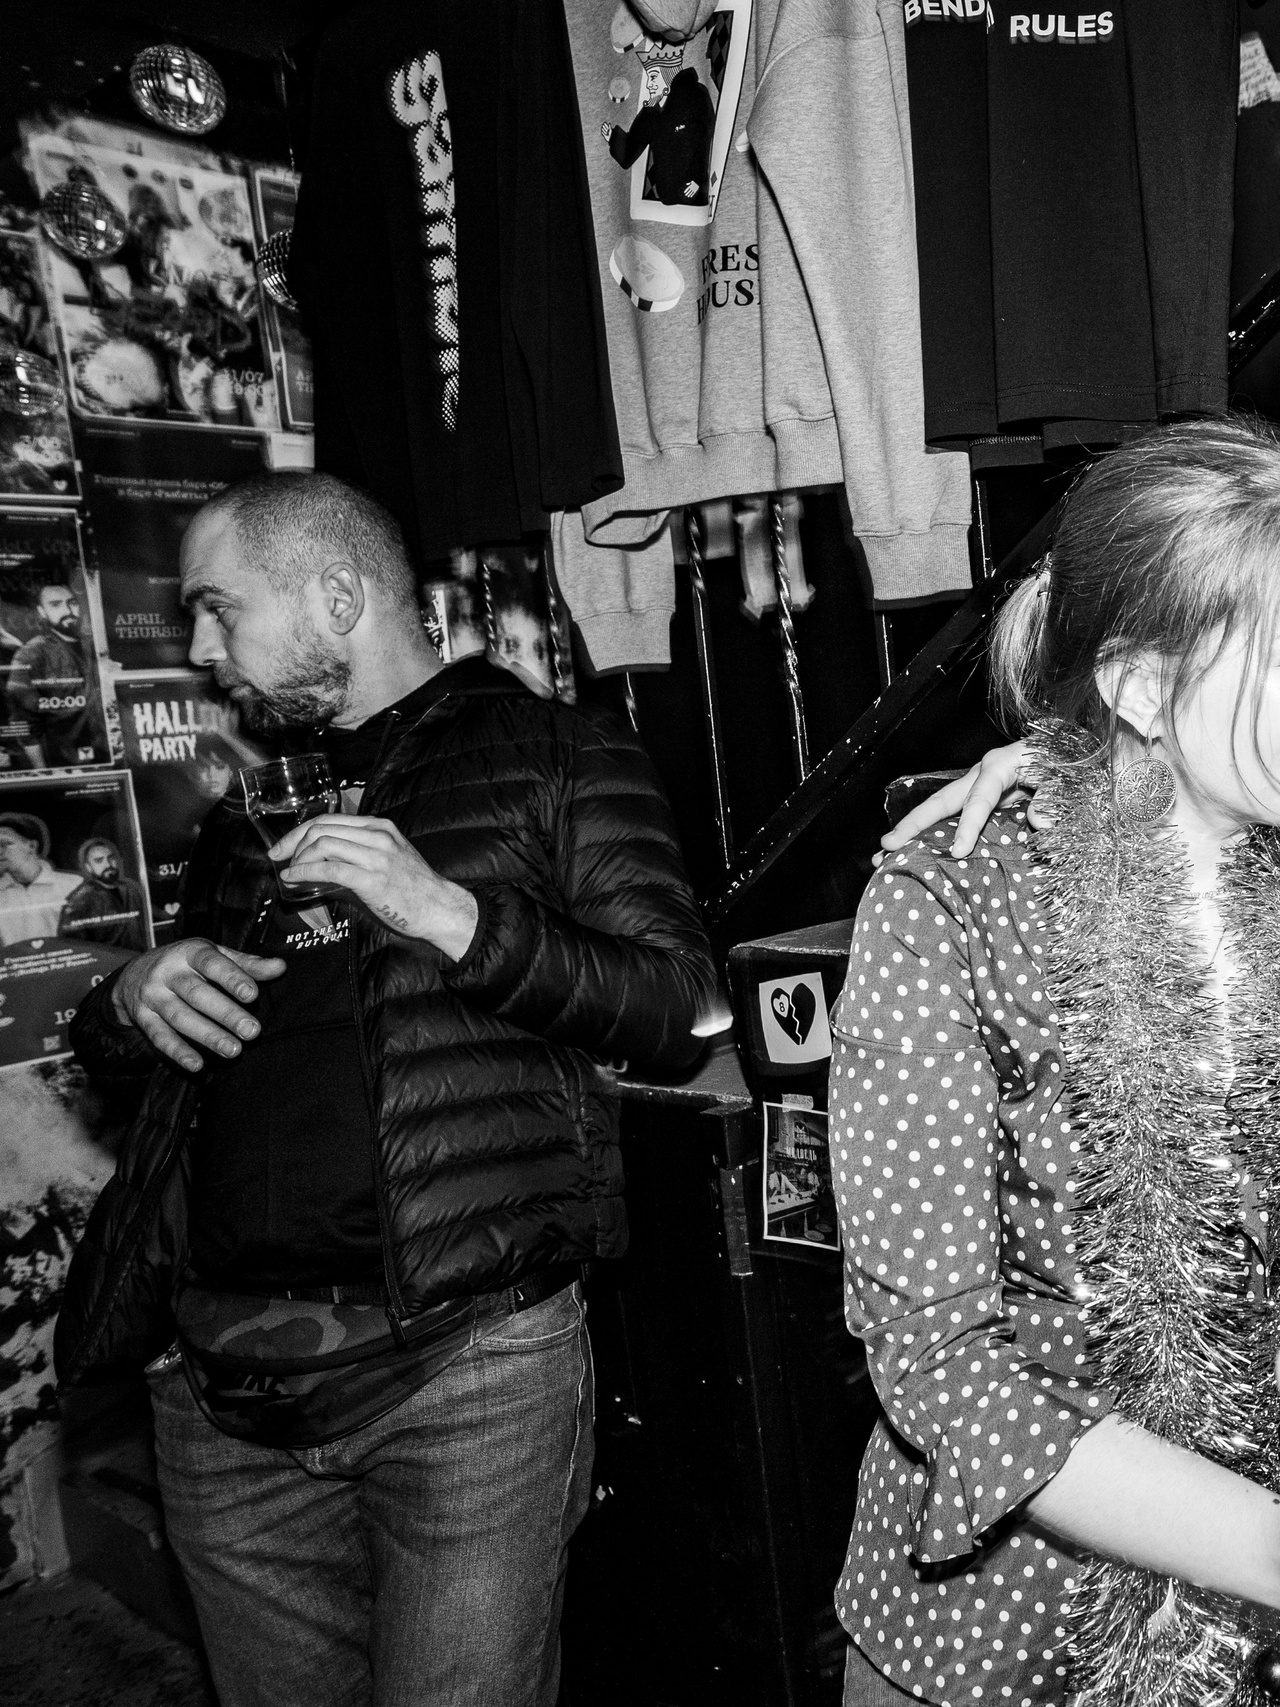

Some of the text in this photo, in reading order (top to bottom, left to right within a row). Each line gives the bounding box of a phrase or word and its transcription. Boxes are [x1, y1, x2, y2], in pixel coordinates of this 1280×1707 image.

[1010, 11, 1114, 38] RULES
[697, 279, 761, 325] HOUS
[115, 612, 166, 626] APRIL
[38, 695, 87, 709] 20:00
[139, 733, 198, 764] PARTY
[286, 931, 310, 944] NOT
[312, 924, 334, 938] THE
[296, 938, 320, 950] BUT
